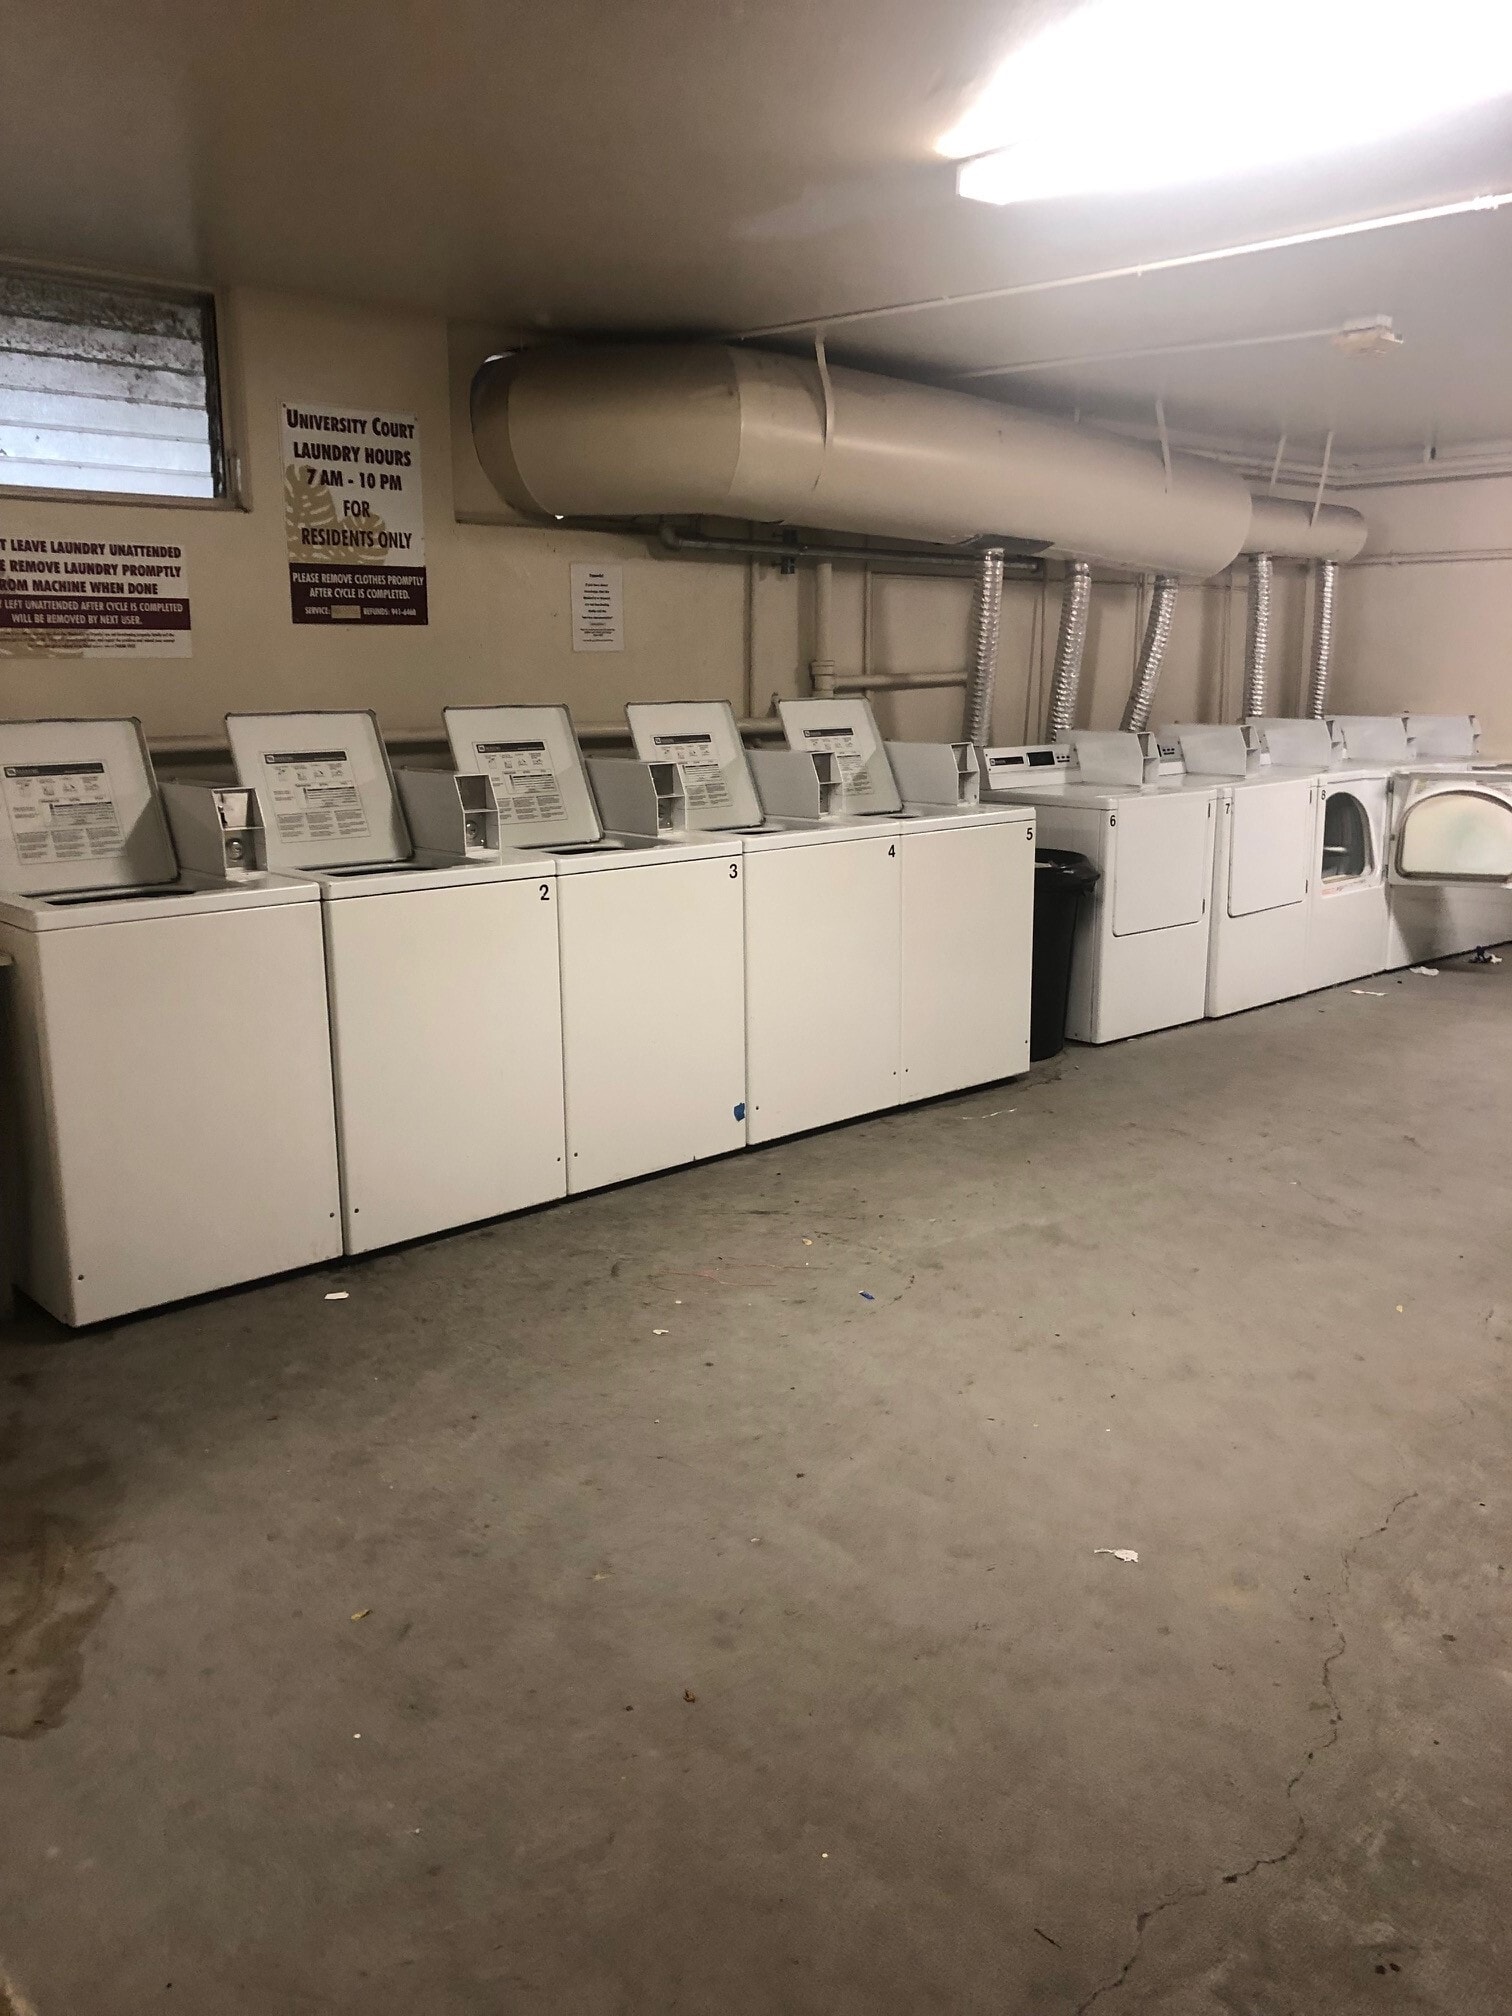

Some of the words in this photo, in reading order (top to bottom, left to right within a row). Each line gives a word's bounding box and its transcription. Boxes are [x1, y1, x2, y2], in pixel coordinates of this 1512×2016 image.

[293, 441, 360, 462] LAUNDRY
[364, 446, 411, 467] HOURS
[306, 468, 316, 485] 7
[320, 469, 343, 487] AM
[360, 472, 376, 489] 10
[380, 473, 402, 491] PM
[343, 499, 370, 518] FOR
[301, 527, 374, 547] RESIDENTS
[378, 531, 412, 549] ONLY
[10, 539, 47, 553] LEAVE
[50, 541, 105, 555] LAUNDRY
[109, 543, 181, 558] UNATTENDED
[9, 559, 60, 574] REMOVE
[64, 561, 118, 576] LAUNDRY
[122, 564, 181, 578] PROMPTLY
[0, 578, 28, 592] ROM
[32, 579, 86, 593] MACHINE
[90, 581, 124, 594] WHEN
[127, 582, 158, 595] DONE
[292, 572, 319, 583] PLEASE
[321, 573, 352, 584] REMOVE
[354, 574, 386, 585] CLOTHES
[388, 575, 424, 586] PROMPTLY
[309, 587, 332, 598] AFTER
[334, 588, 356, 598] CYCLE
[358, 588, 365, 598] IS
[366, 589, 410, 599] COMPLETED.
[4, 599, 22, 610] LEFT
[25, 600, 79, 611] UNATTENDED
[81, 601, 104, 611] AFTER
[106, 602, 128, 612] CYCLE
[130, 602, 137, 611] IS
[139, 602, 183, 612] COMPLETED
[11, 613, 32, 623] WILL
[34, 613, 45, 624] BE
[46, 614, 86, 624] REMOVED
[87, 614, 98, 624] BY
[100, 615, 119, 624] NEXT
[1225, 803, 1231, 814] 7
[1109, 815, 1116, 827] 6
[1026, 827, 1033, 840] 5
[888, 844, 896, 858] 4
[729, 863, 738, 879] 3
[539, 884, 550, 901] 2
